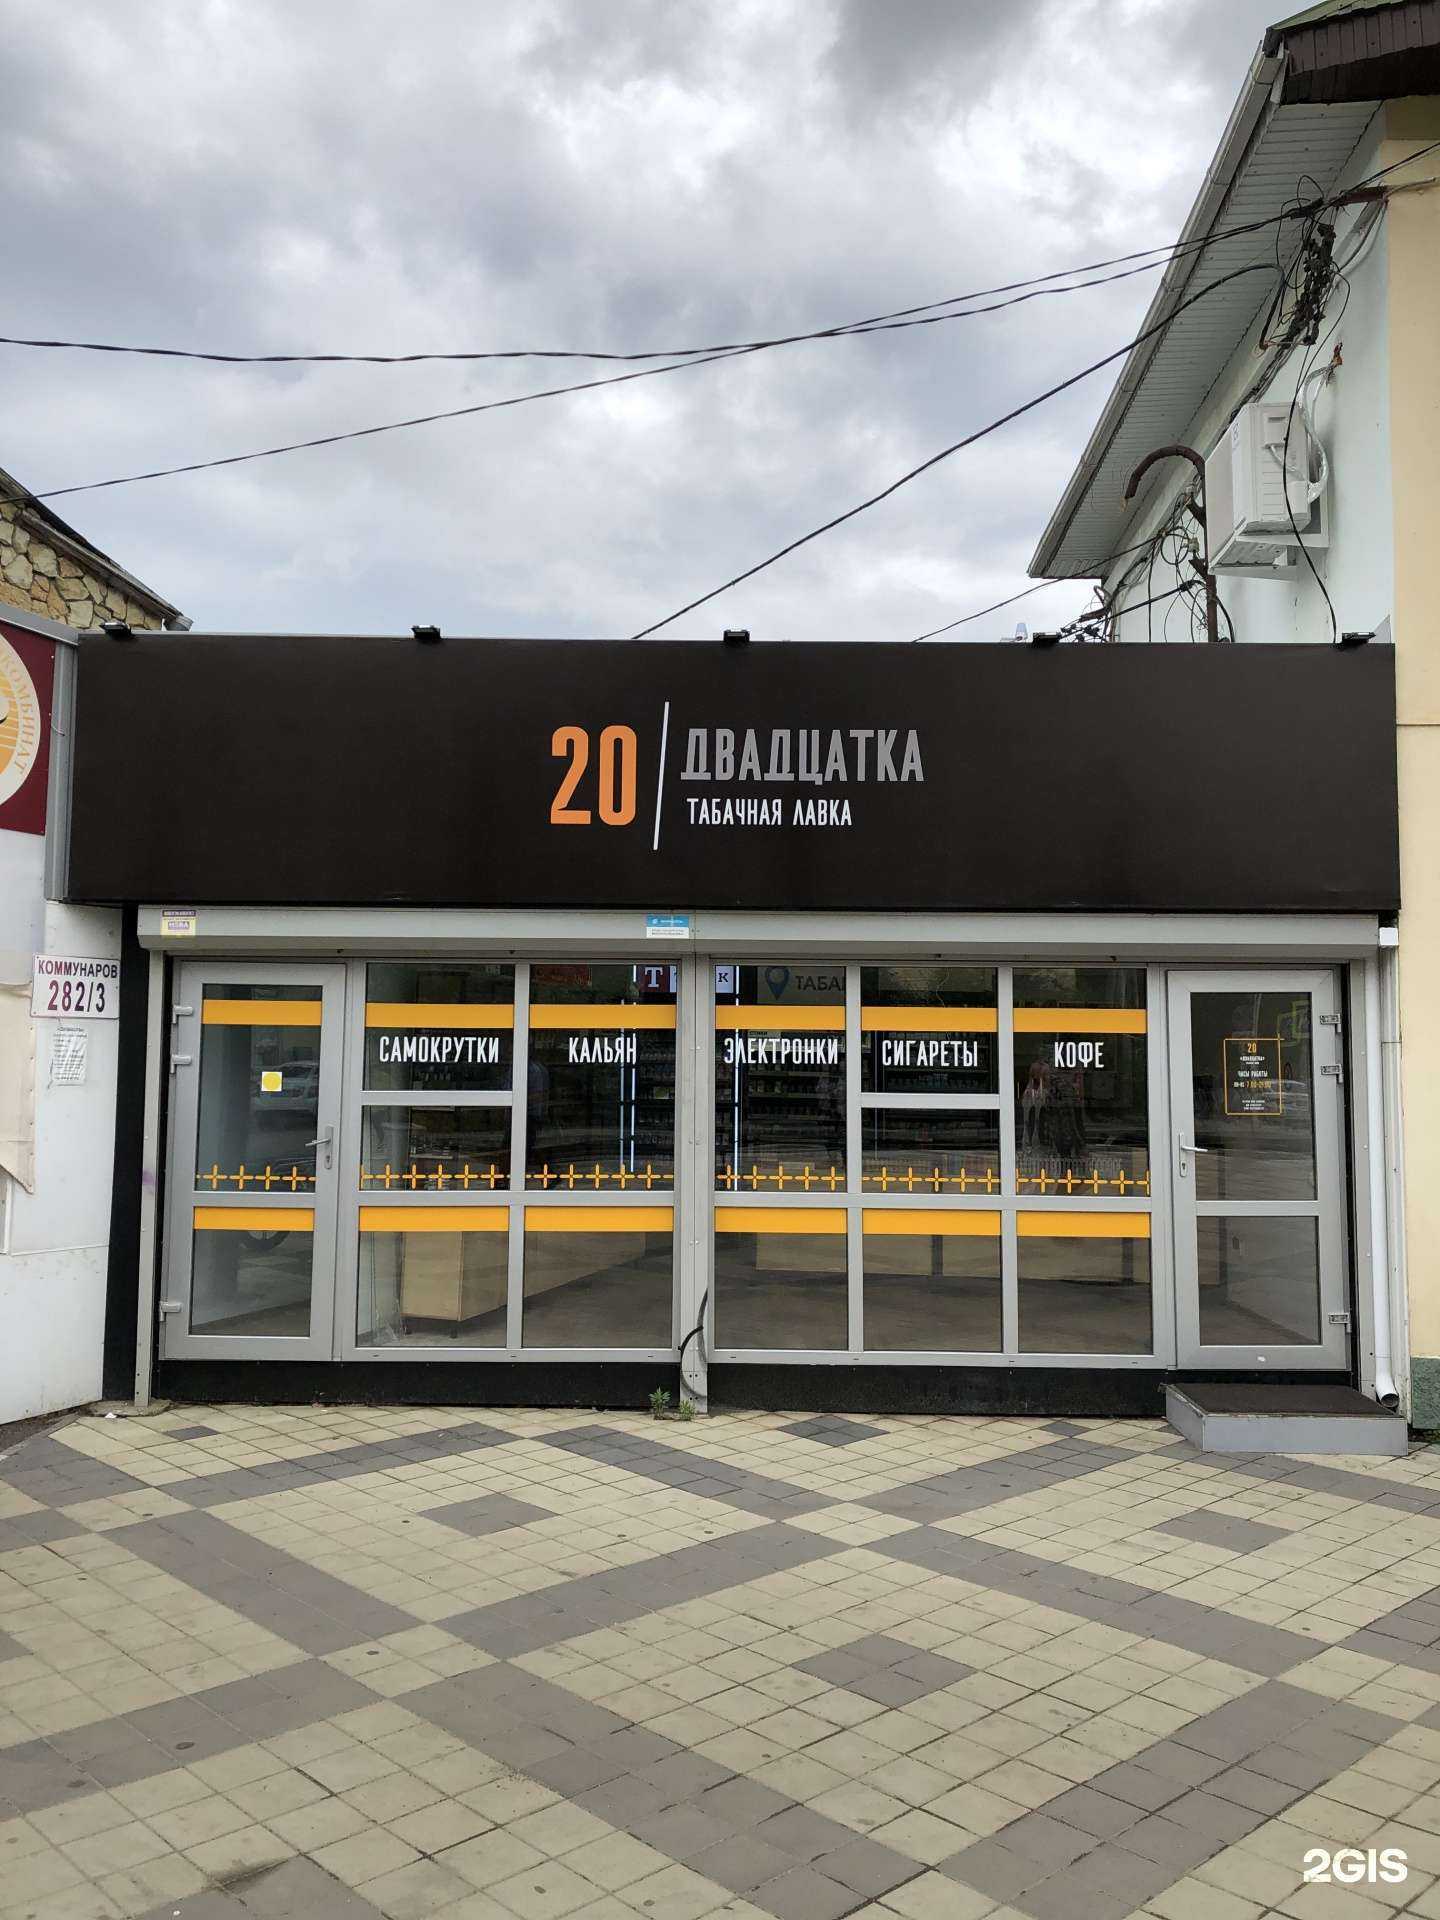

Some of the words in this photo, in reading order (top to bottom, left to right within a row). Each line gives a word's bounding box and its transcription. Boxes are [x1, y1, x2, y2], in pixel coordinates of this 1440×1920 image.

[681, 728, 924, 786] ДВАДЦАТКА
[550, 725, 637, 826] 20
[686, 797, 782, 826] ТАБАЧНАЯ
[792, 799, 853, 826] ЛАВКА
[38, 959, 118, 979] КОММУНАРОВ
[47, 979, 106, 1013] 282/3
[379, 1035, 500, 1064] САМОКРУТКИ
[568, 1036, 637, 1065] КАЛЬЯН
[723, 1037, 839, 1065] ЭЛЕКТРОНКИ
[881, 1039, 978, 1067] СИГАРЕТЫ
[1054, 1041, 1105, 1068] КОФЕ
